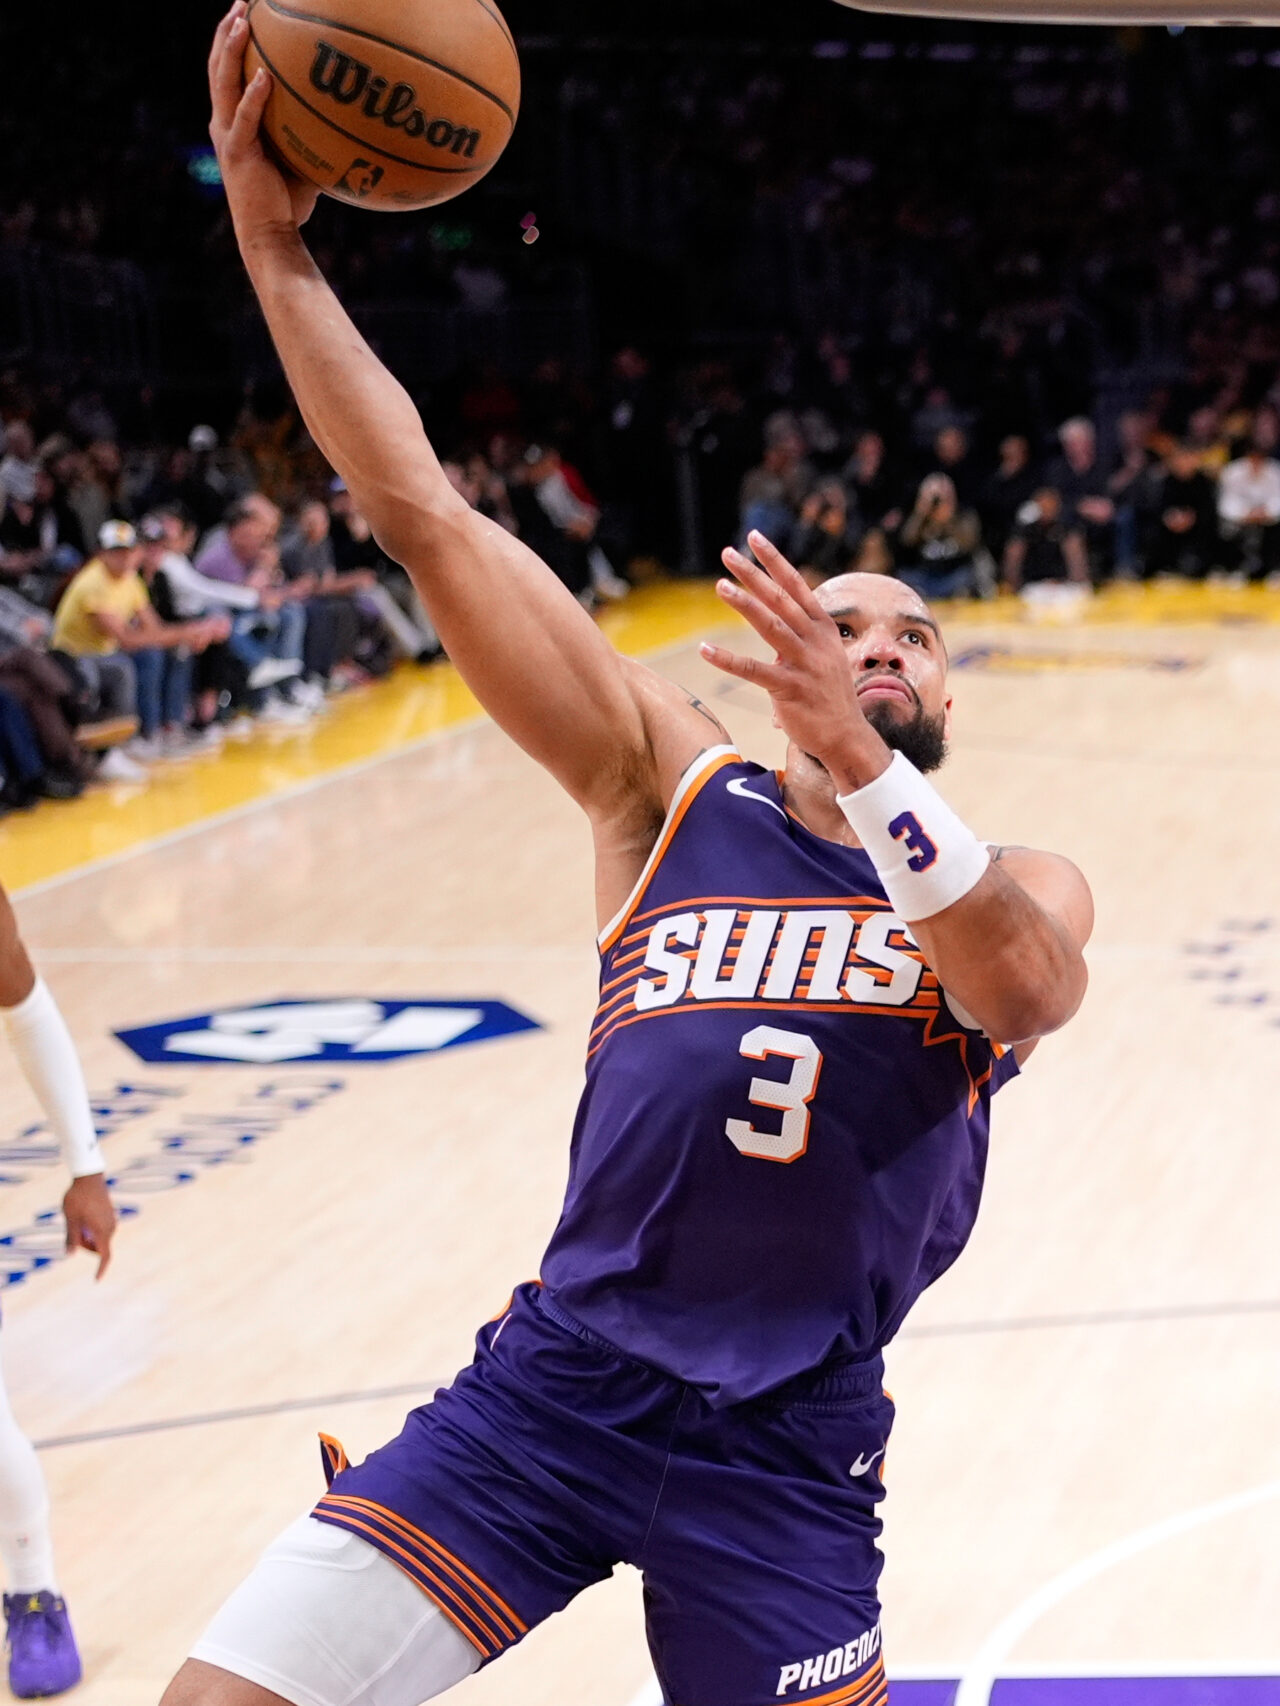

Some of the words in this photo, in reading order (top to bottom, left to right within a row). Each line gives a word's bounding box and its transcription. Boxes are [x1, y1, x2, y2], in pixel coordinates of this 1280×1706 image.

[308, 39, 482, 158] Wilson
[888, 811, 939, 873] 3
[634, 908, 922, 1011] SUNS
[725, 1025, 823, 1164] 3
